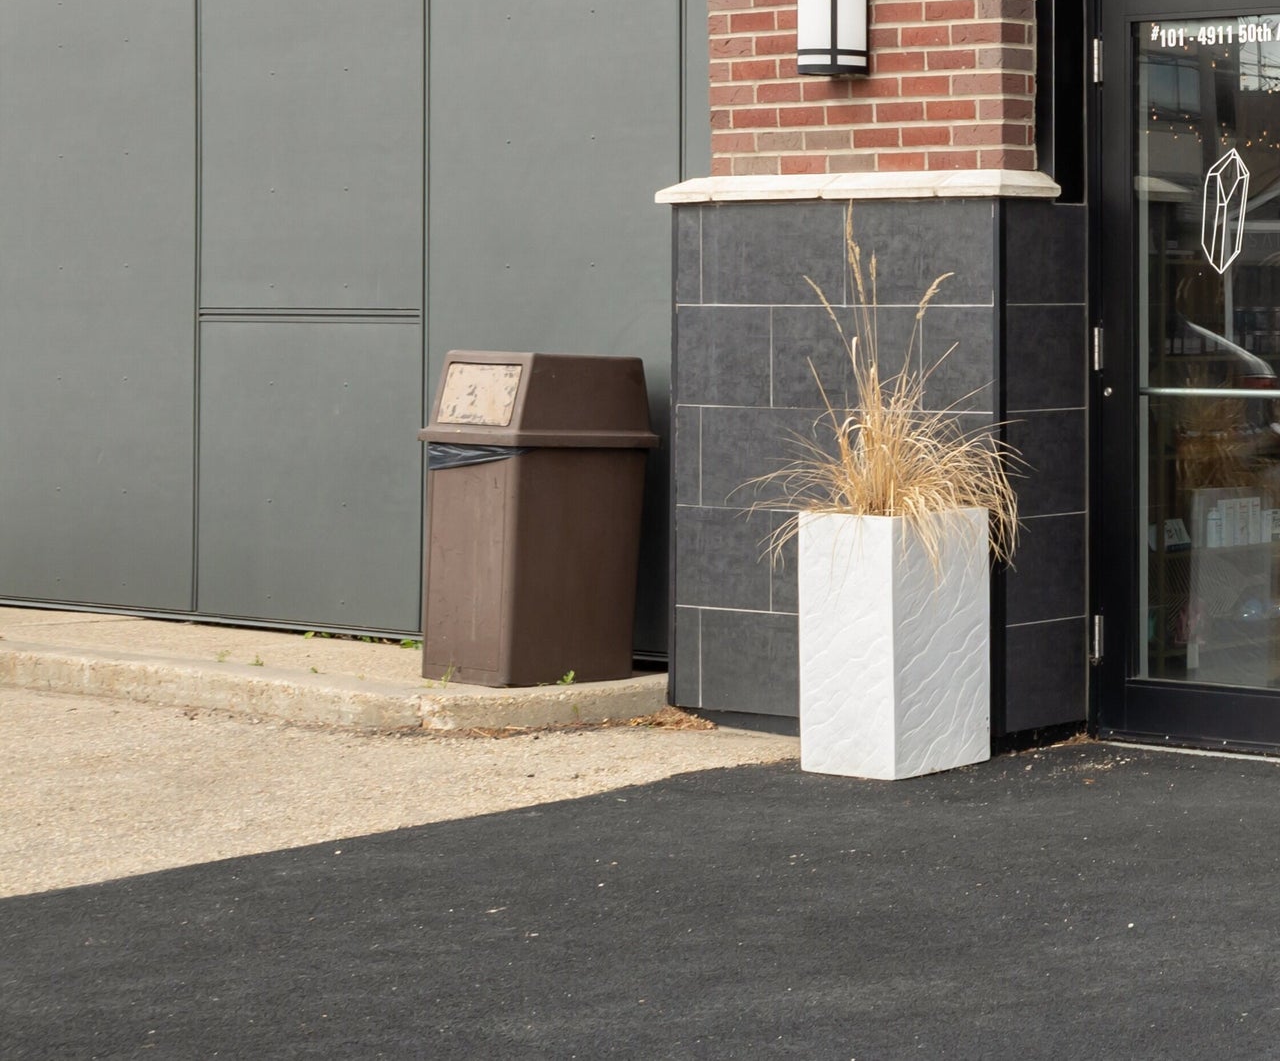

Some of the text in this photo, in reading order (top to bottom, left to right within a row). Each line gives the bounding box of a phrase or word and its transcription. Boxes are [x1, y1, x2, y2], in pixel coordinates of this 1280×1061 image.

[1151, 25, 1185, 48] #101
[1197, 25, 1233, 46] 4911
[1238, 23, 1272, 44] 50th
